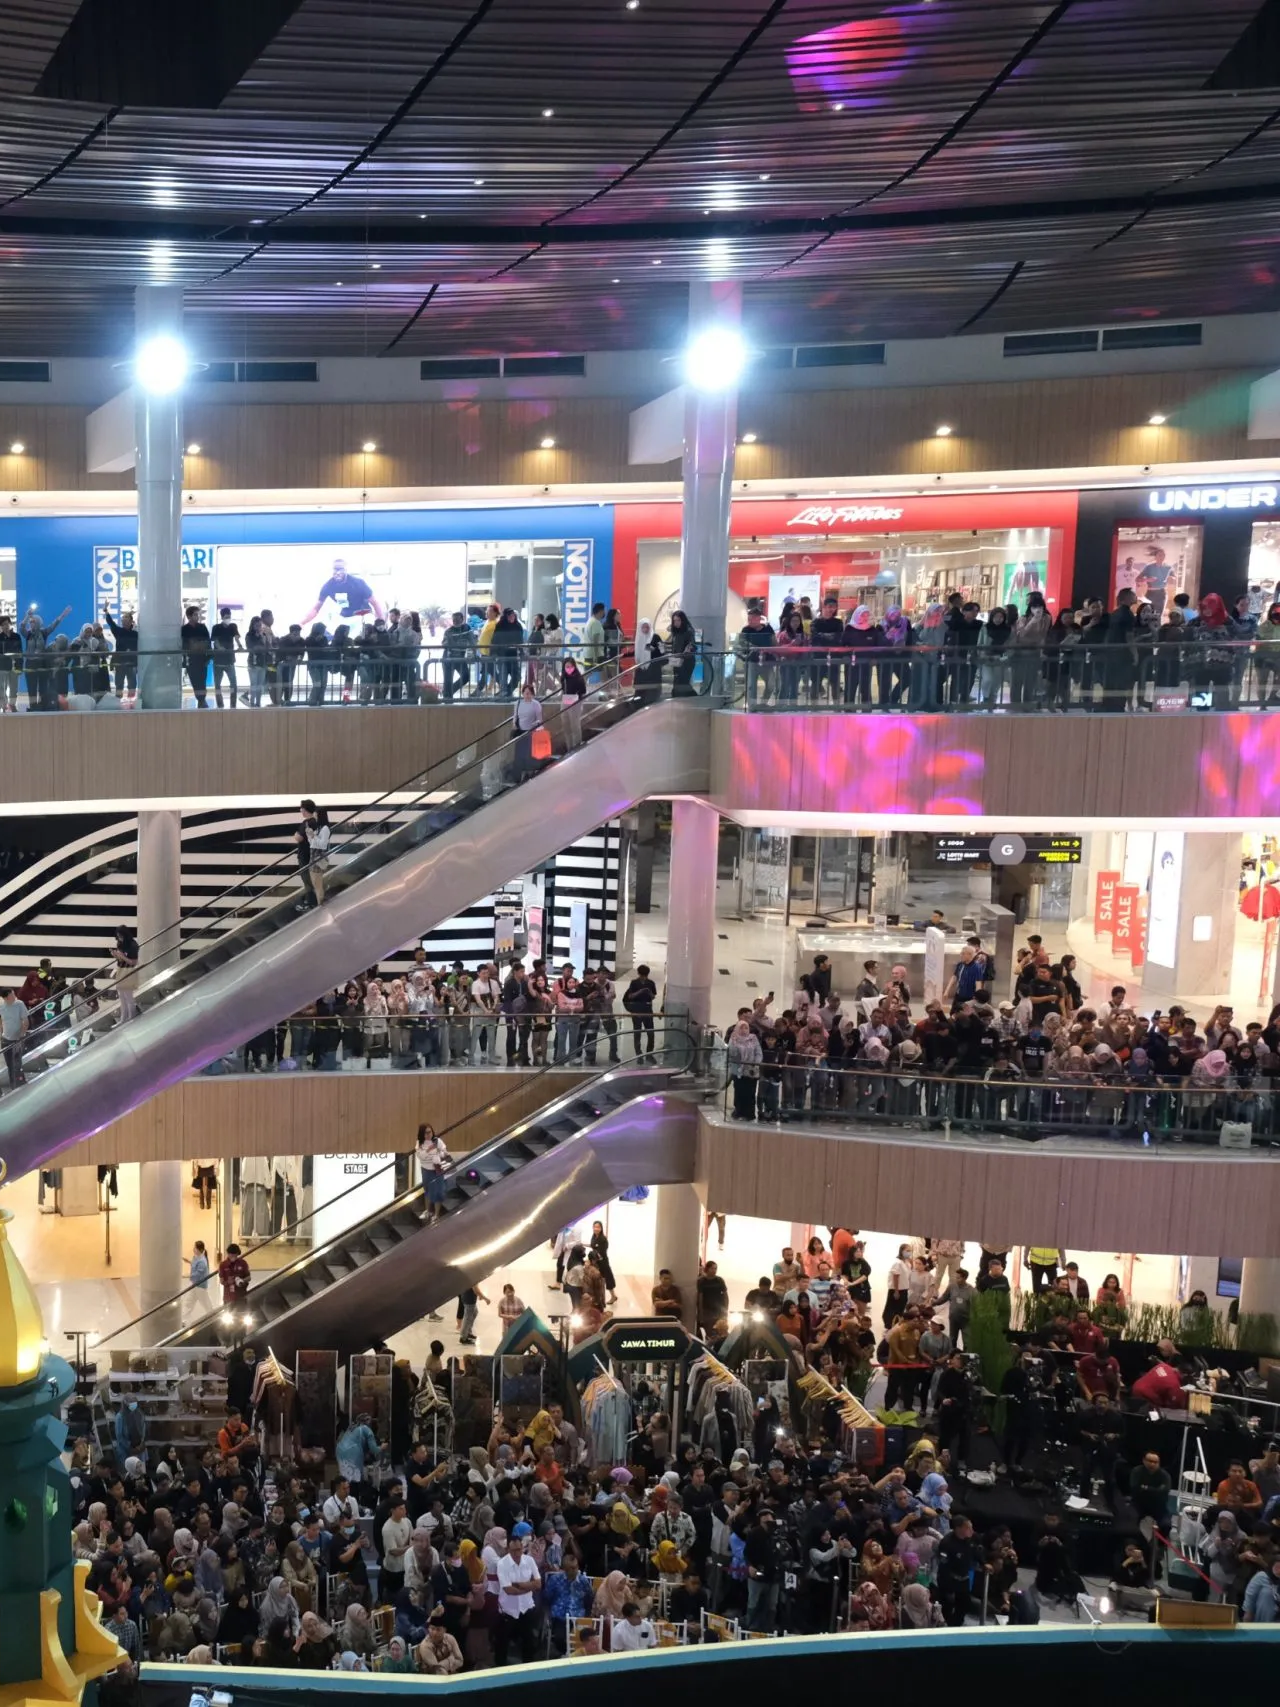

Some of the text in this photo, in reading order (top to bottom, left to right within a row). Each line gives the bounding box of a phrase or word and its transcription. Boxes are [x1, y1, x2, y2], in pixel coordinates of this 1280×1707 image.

[1149, 486, 1278, 512] UNDER
[1001, 844, 1014, 856] G
[1099, 880, 1114, 921] SALE
[1117, 895, 1132, 938] SALE
[345, 1164, 367, 1173] STAGE
[620, 1339, 676, 1349] JAWA TIMUR
